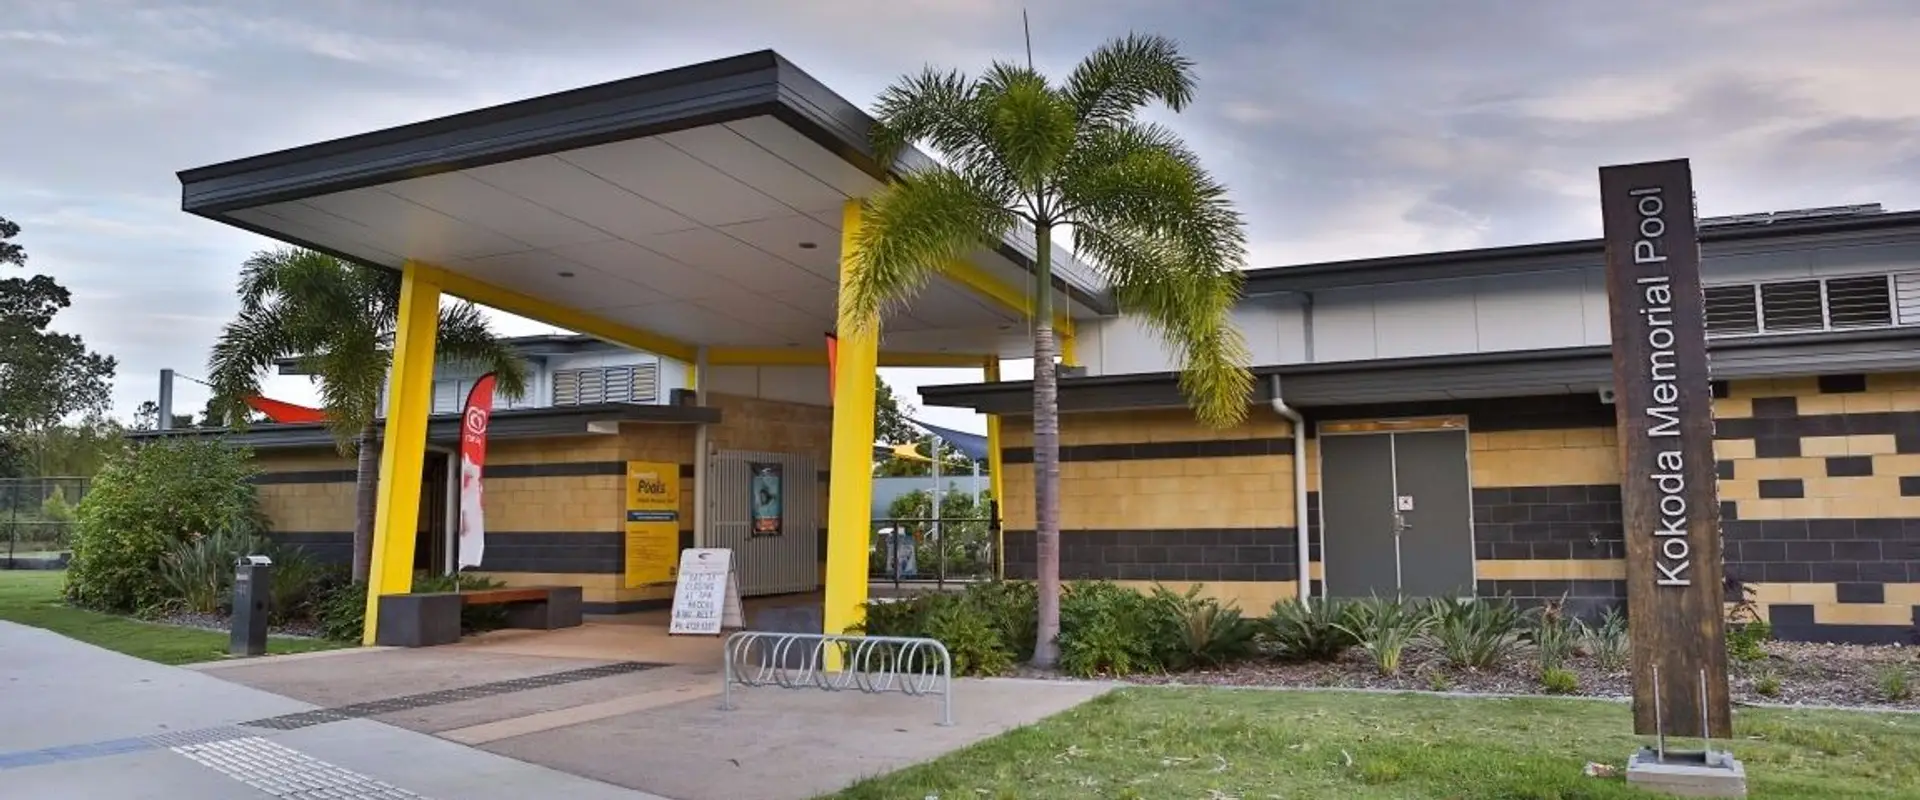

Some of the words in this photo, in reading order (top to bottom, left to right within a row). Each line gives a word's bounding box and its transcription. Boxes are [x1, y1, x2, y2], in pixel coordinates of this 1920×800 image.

[1629, 187, 1668, 264] Pool
[1636, 276, 1681, 436] Memorial
[638, 479, 666, 494] Pools
[1650, 450, 1691, 586] Kokoda
